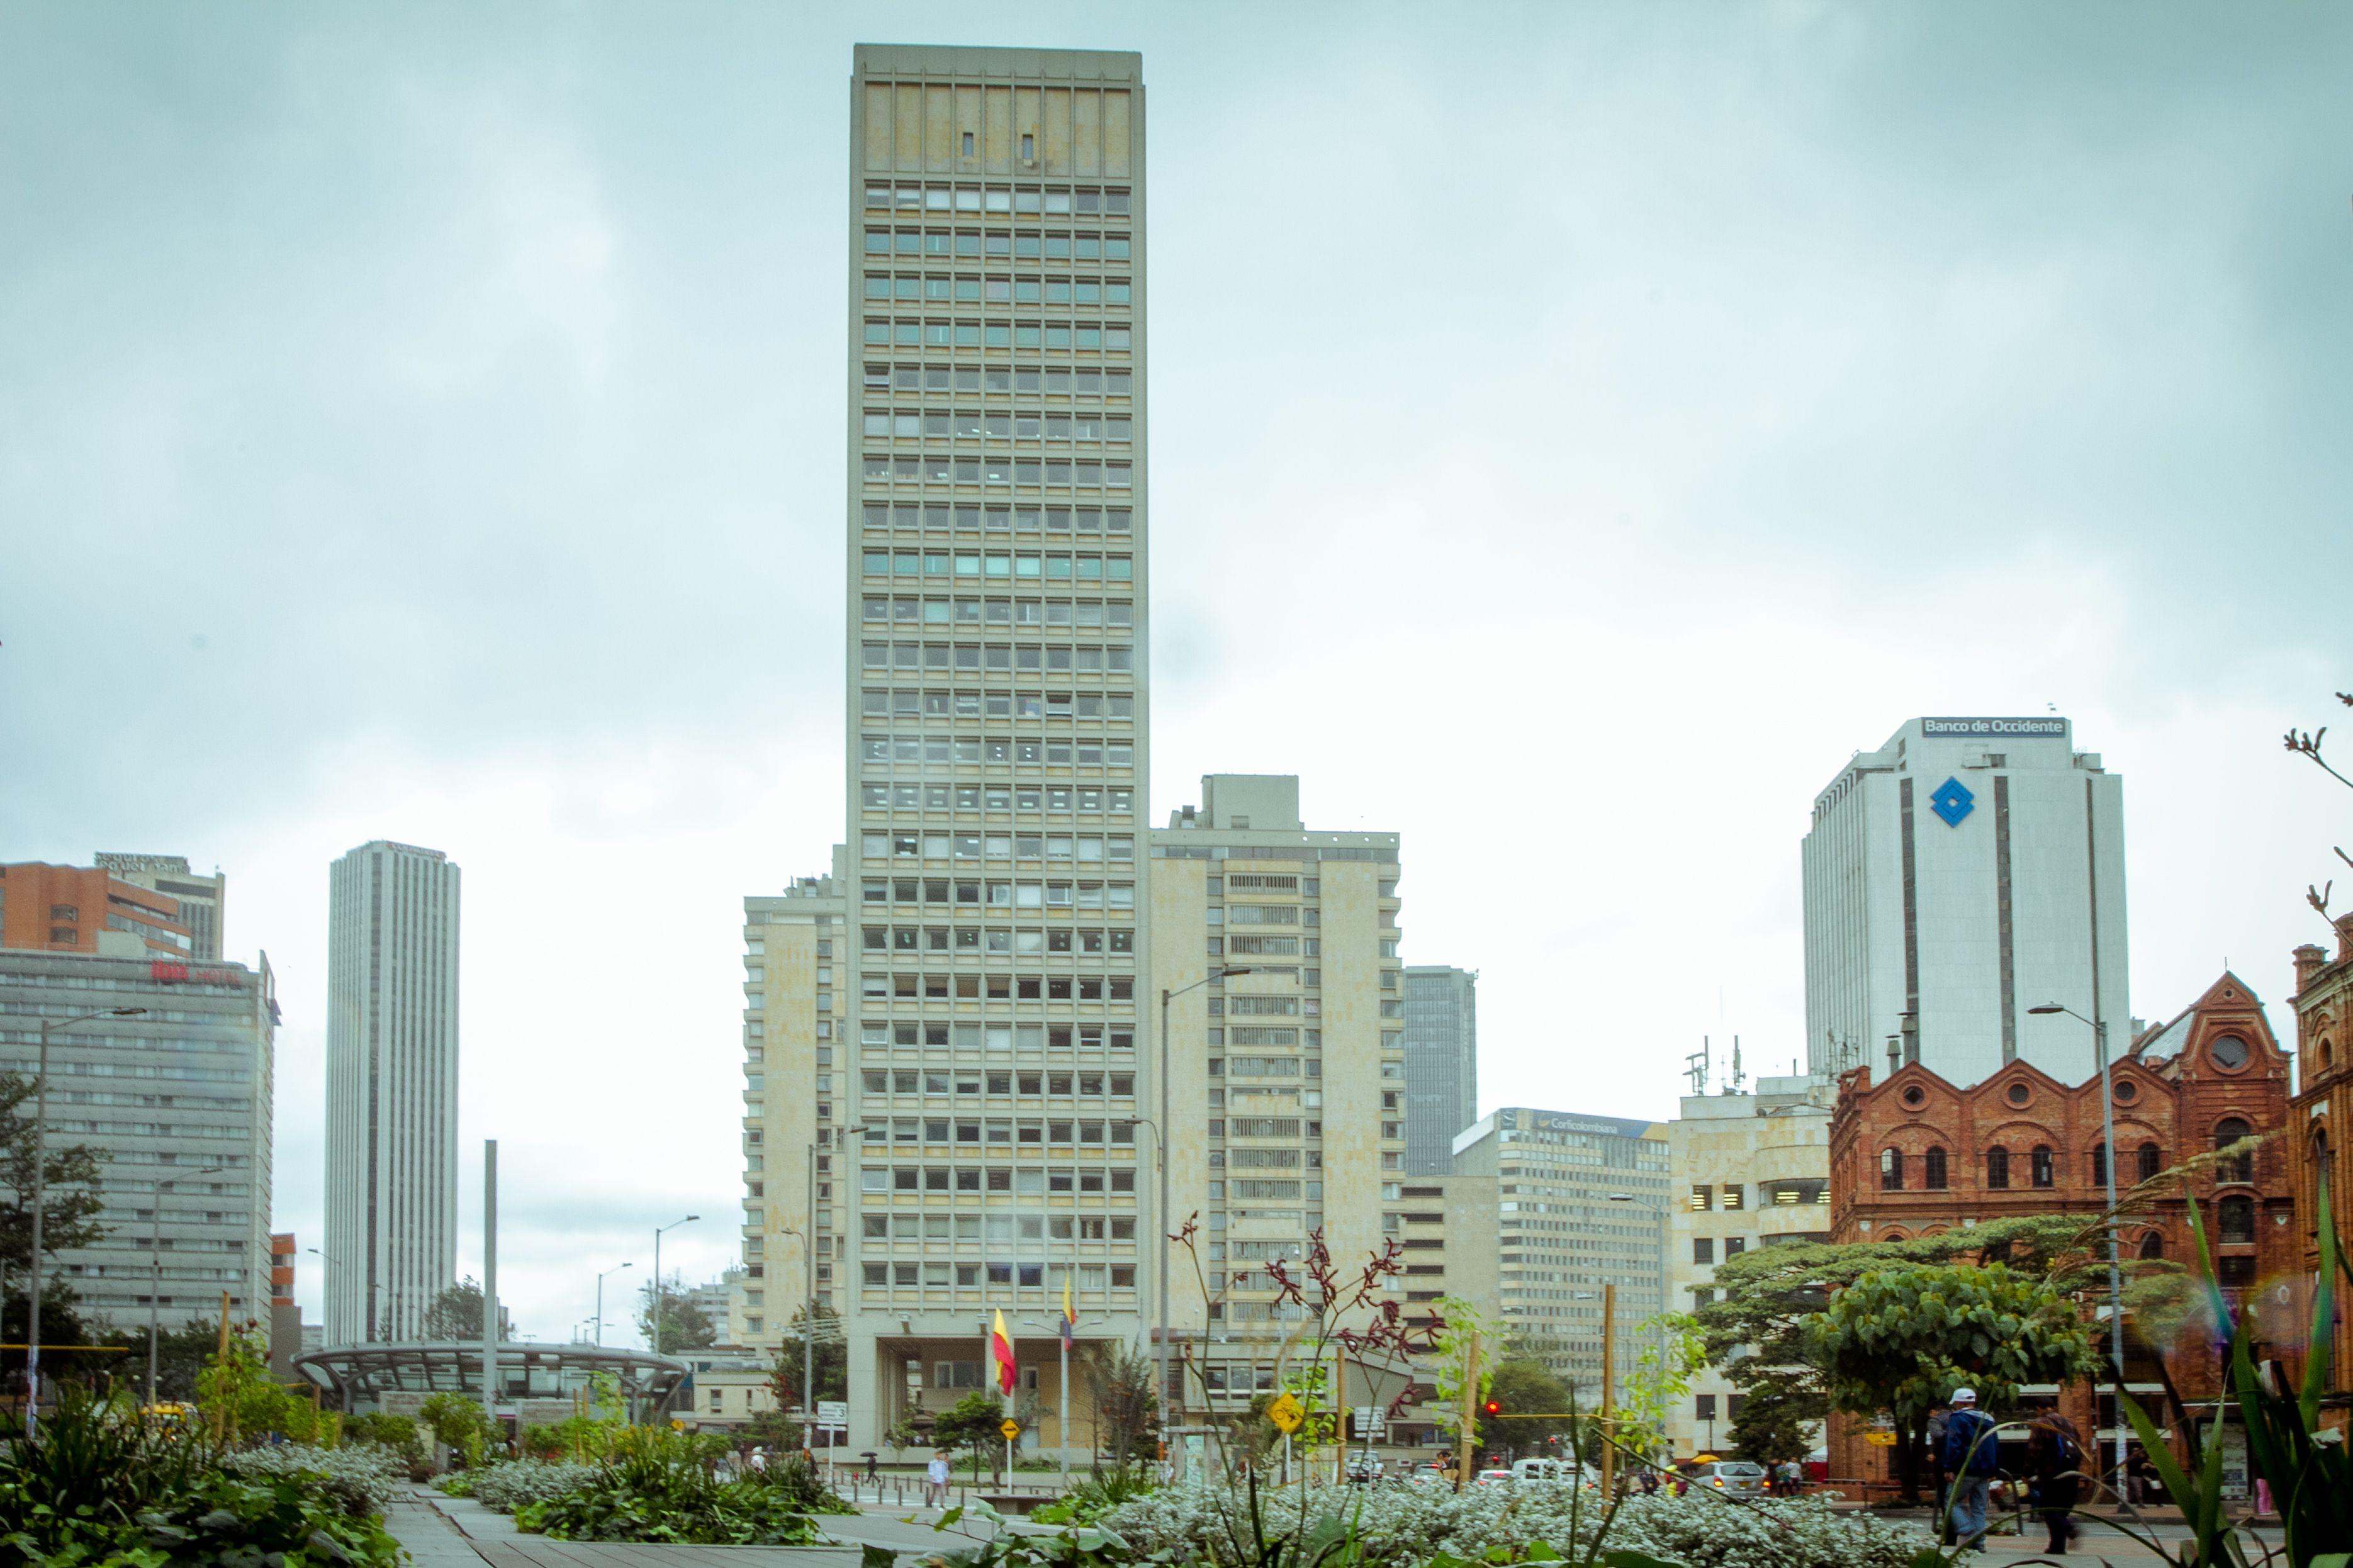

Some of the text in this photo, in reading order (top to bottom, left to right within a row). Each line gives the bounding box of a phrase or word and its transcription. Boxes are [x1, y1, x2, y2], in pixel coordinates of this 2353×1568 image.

[1924, 719, 2064, 732] Banco de Occidente
[151, 959, 188, 980] ibis
